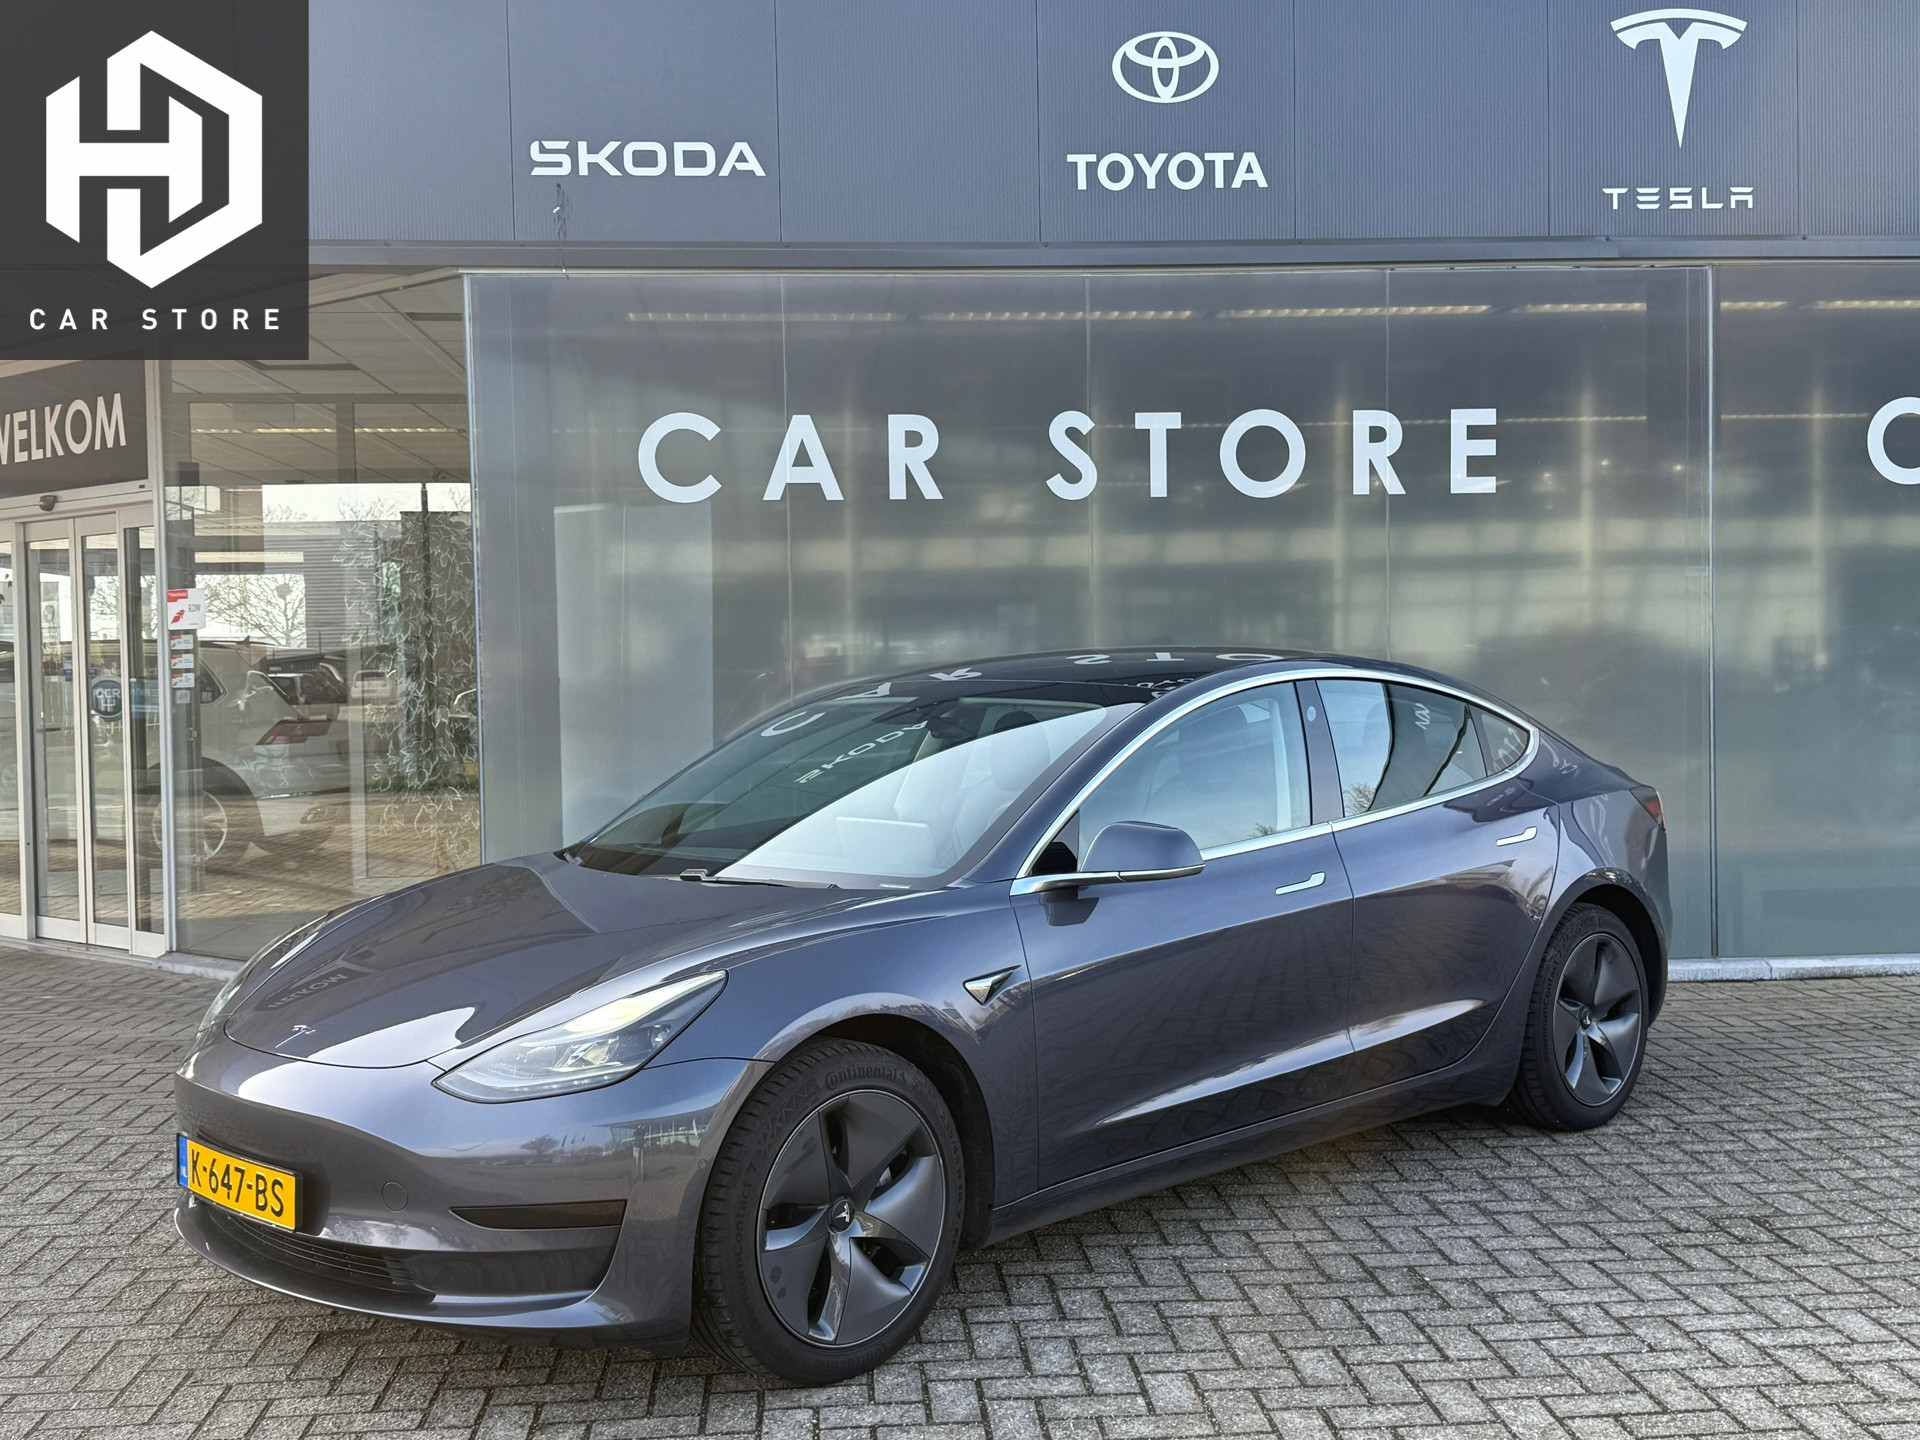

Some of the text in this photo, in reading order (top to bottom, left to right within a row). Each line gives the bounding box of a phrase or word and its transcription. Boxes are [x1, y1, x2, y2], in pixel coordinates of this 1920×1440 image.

[1066, 151, 1269, 191] TOYOTA
[1602, 186, 1754, 210] TESLA
[638, 408, 1498, 504] CAR STORE
[823, 1064, 898, 1089] Continental
[190, 1148, 285, 1218] K-647-BS
